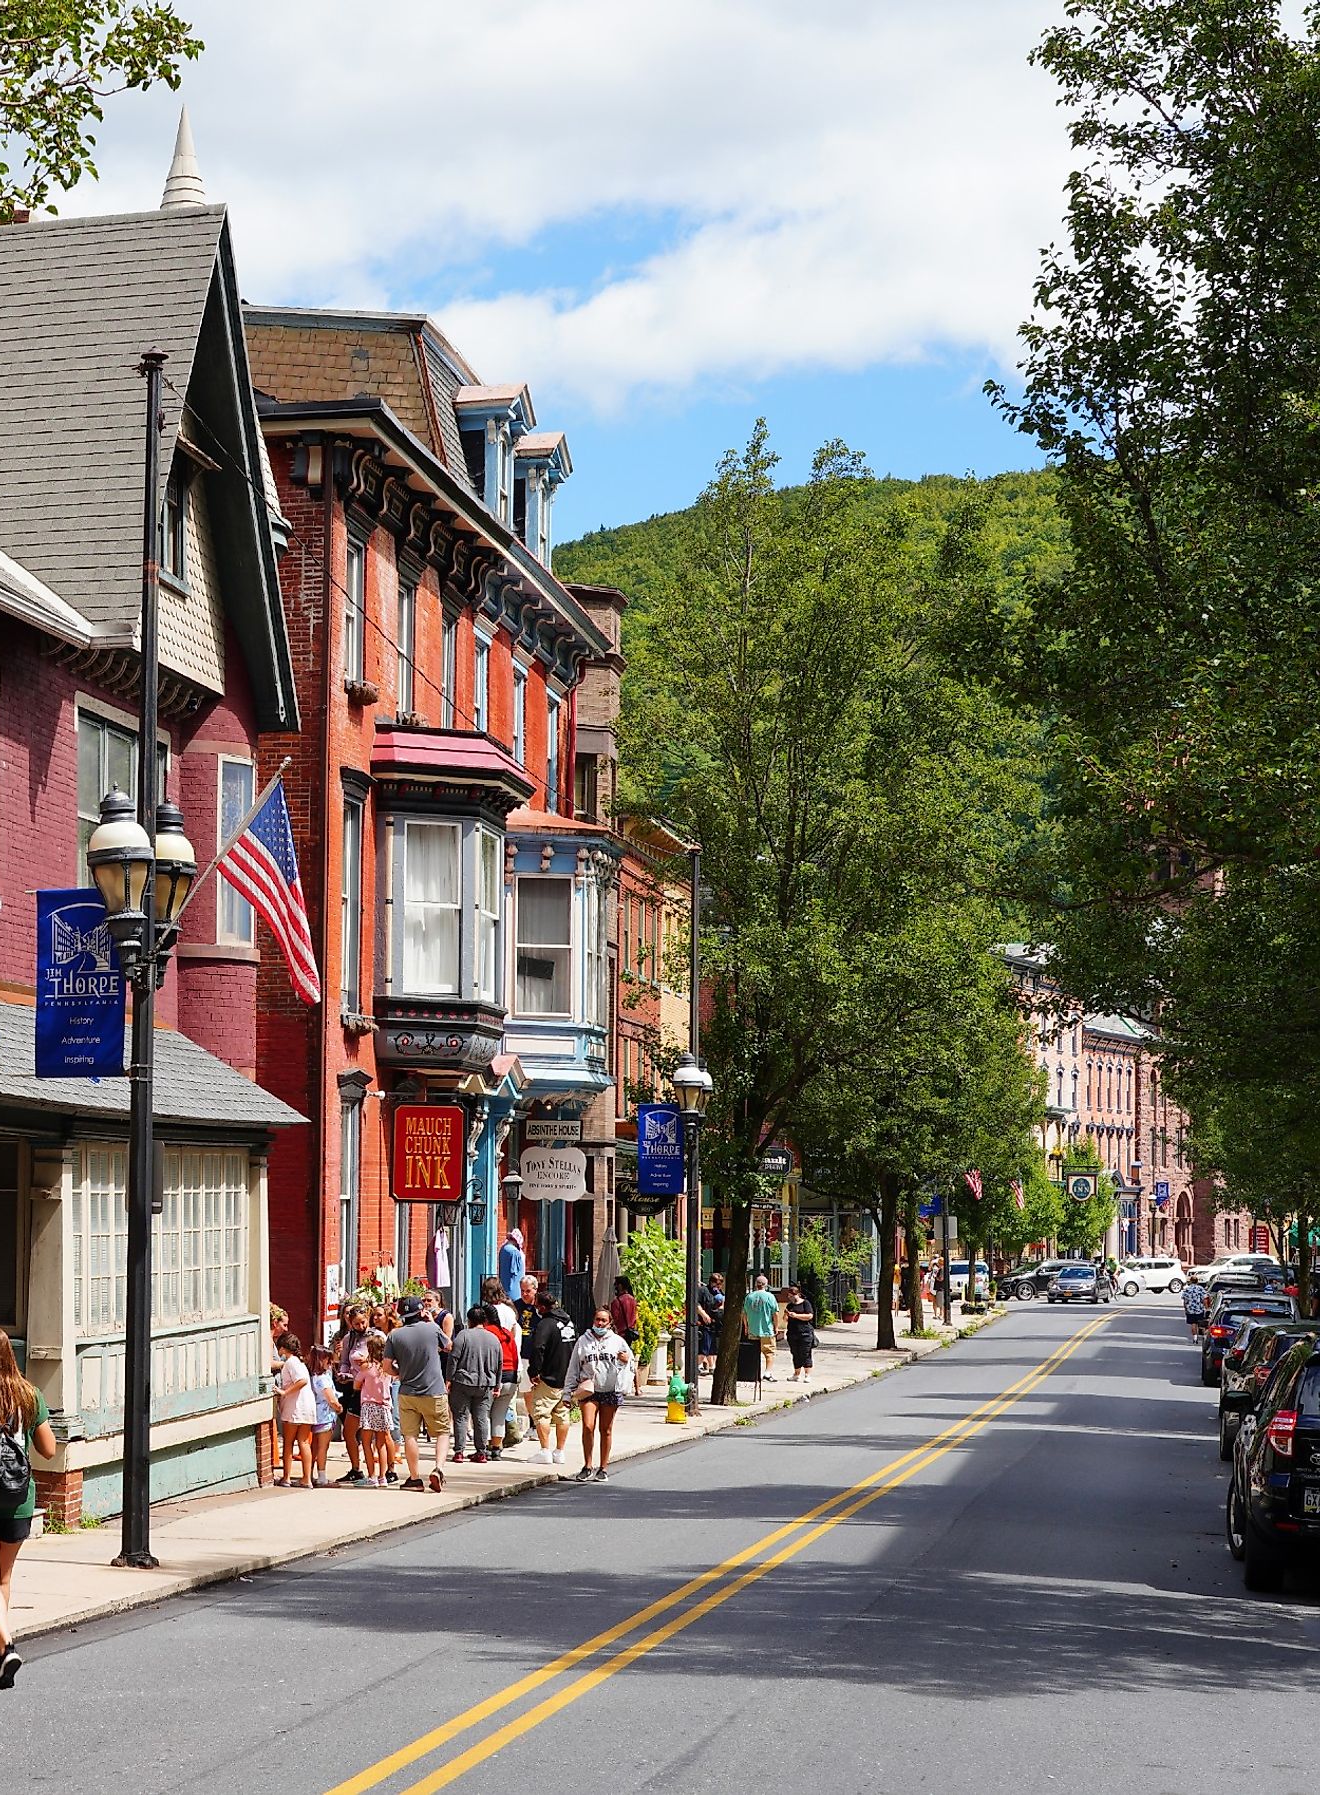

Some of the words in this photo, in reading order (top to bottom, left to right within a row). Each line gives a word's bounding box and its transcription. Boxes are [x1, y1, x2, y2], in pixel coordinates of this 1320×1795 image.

[45, 969, 62, 980] JIM
[49, 970, 119, 998] THORPE
[70, 1017, 94, 1026] History
[61, 1036, 100, 1044] Adventure
[64, 1055, 94, 1065] Inspiring
[405, 1117, 452, 1136] MAUCH
[527, 1125, 557, 1136] ABSINTHE
[558, 1125, 579, 1136] HOUSE
[405, 1136, 451, 1155] CHUNK
[644, 1142, 680, 1156] THORPE
[764, 1156, 787, 1165] ault
[405, 1155, 451, 1189] INK
[526, 1160, 545, 1173] TONY
[537, 1172, 570, 1180] ENCORE
